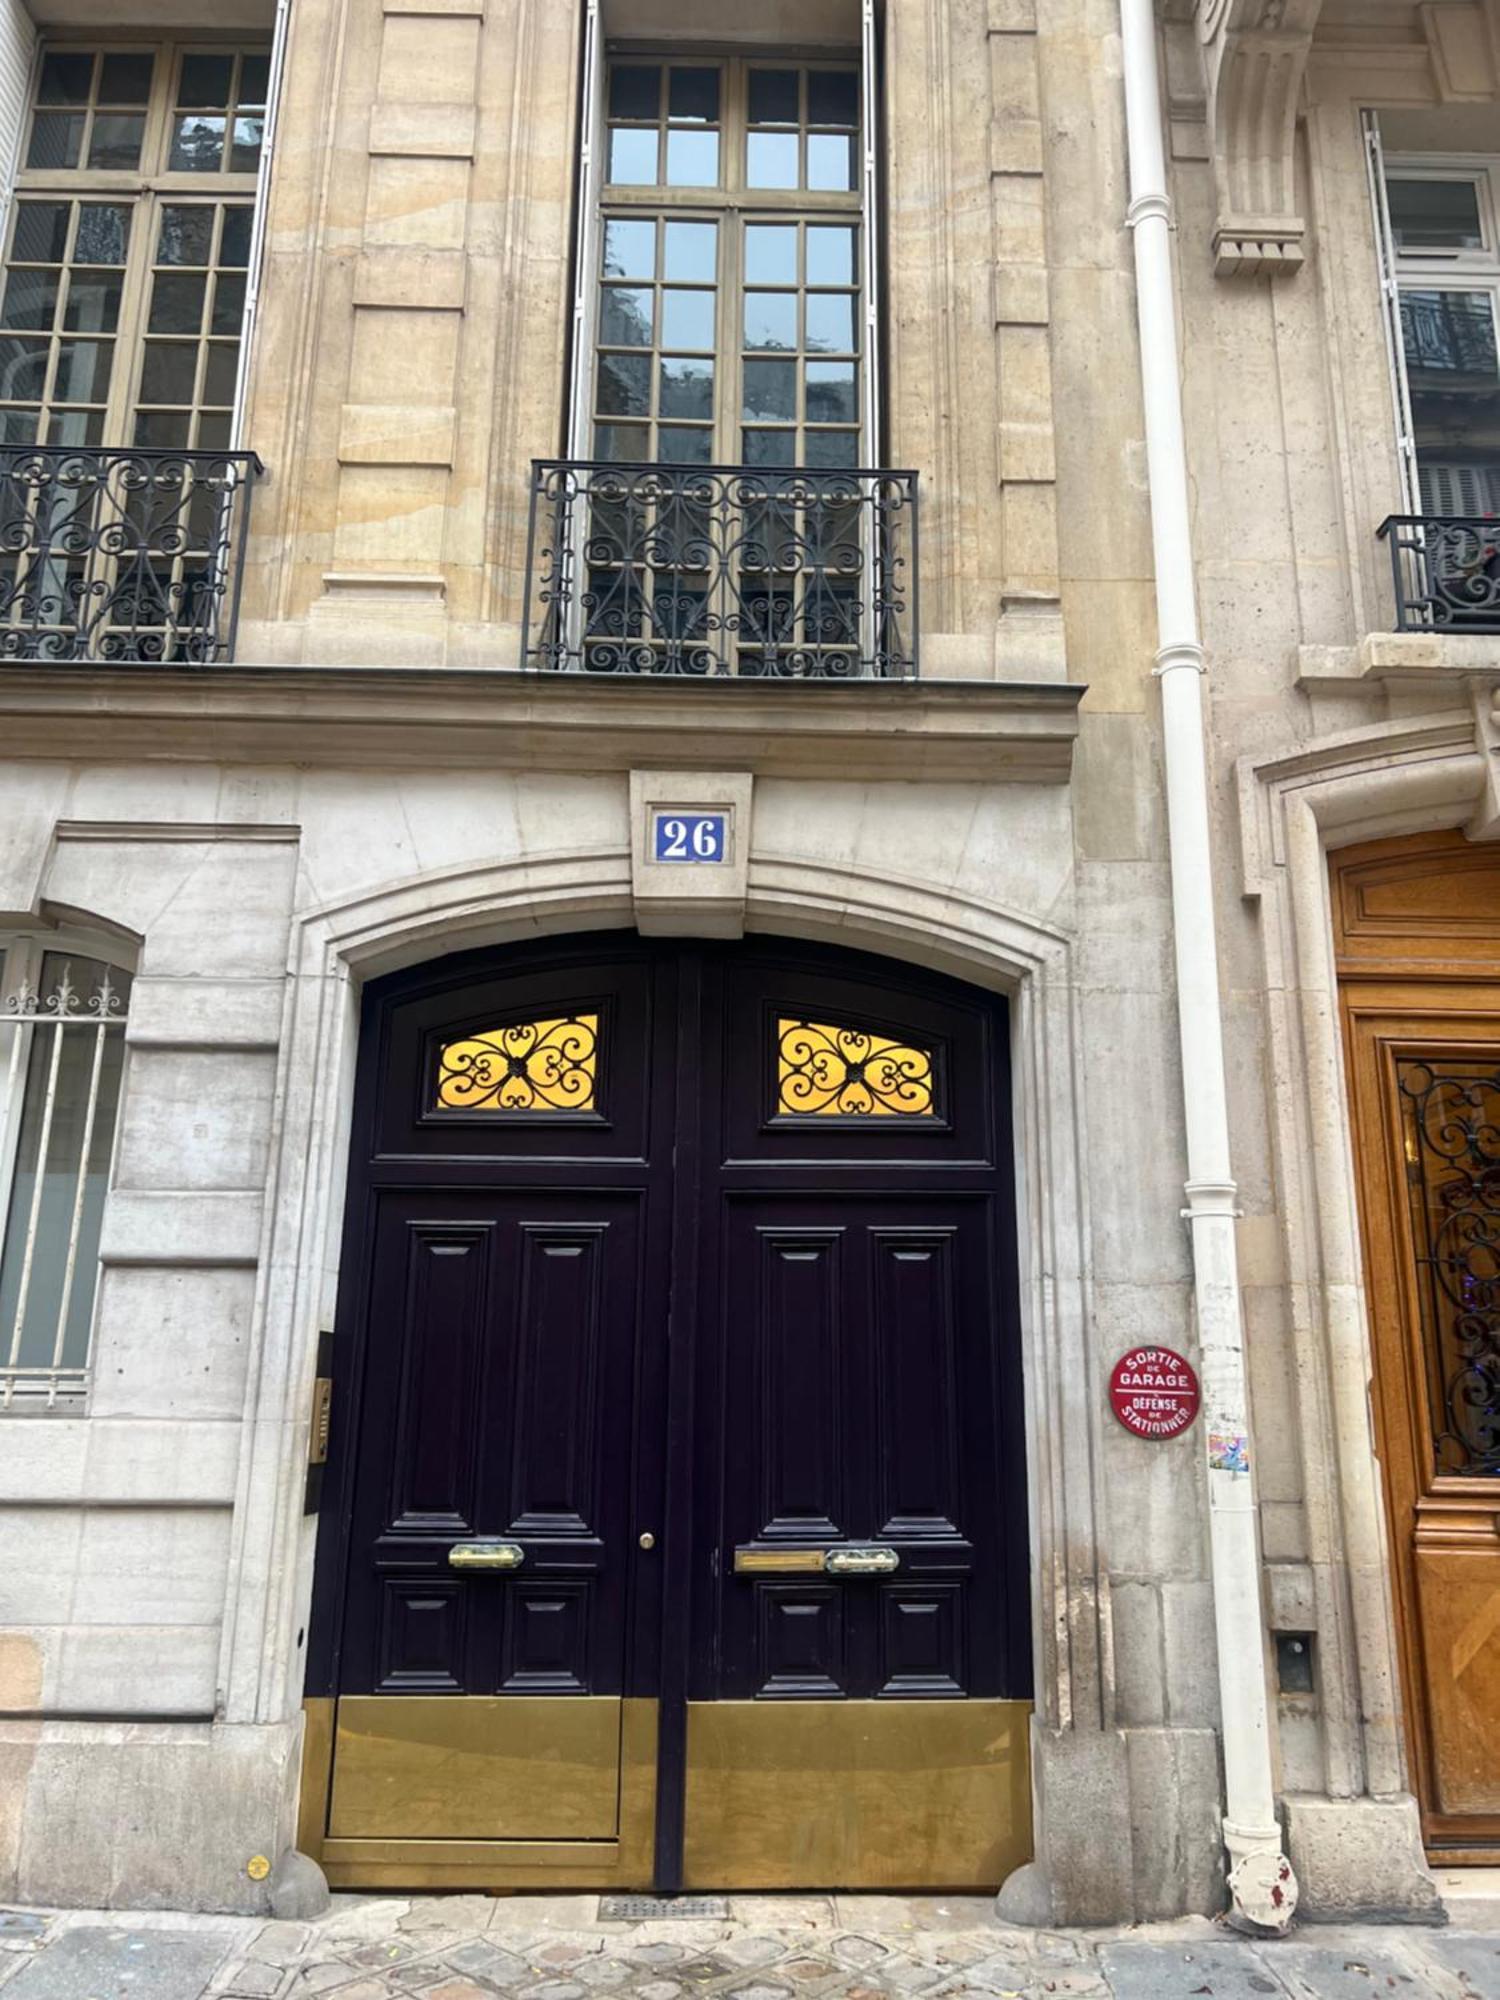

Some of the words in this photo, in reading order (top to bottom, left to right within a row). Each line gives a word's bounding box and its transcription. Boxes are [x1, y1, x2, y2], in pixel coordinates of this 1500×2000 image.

[663, 820, 717, 857] 26
[1125, 1351, 1181, 1371] SORTIE
[1147, 1365, 1160, 1373] DE
[1120, 1373, 1188, 1387] GARAGE
[1121, 1405, 1190, 1434] STATIONNER
